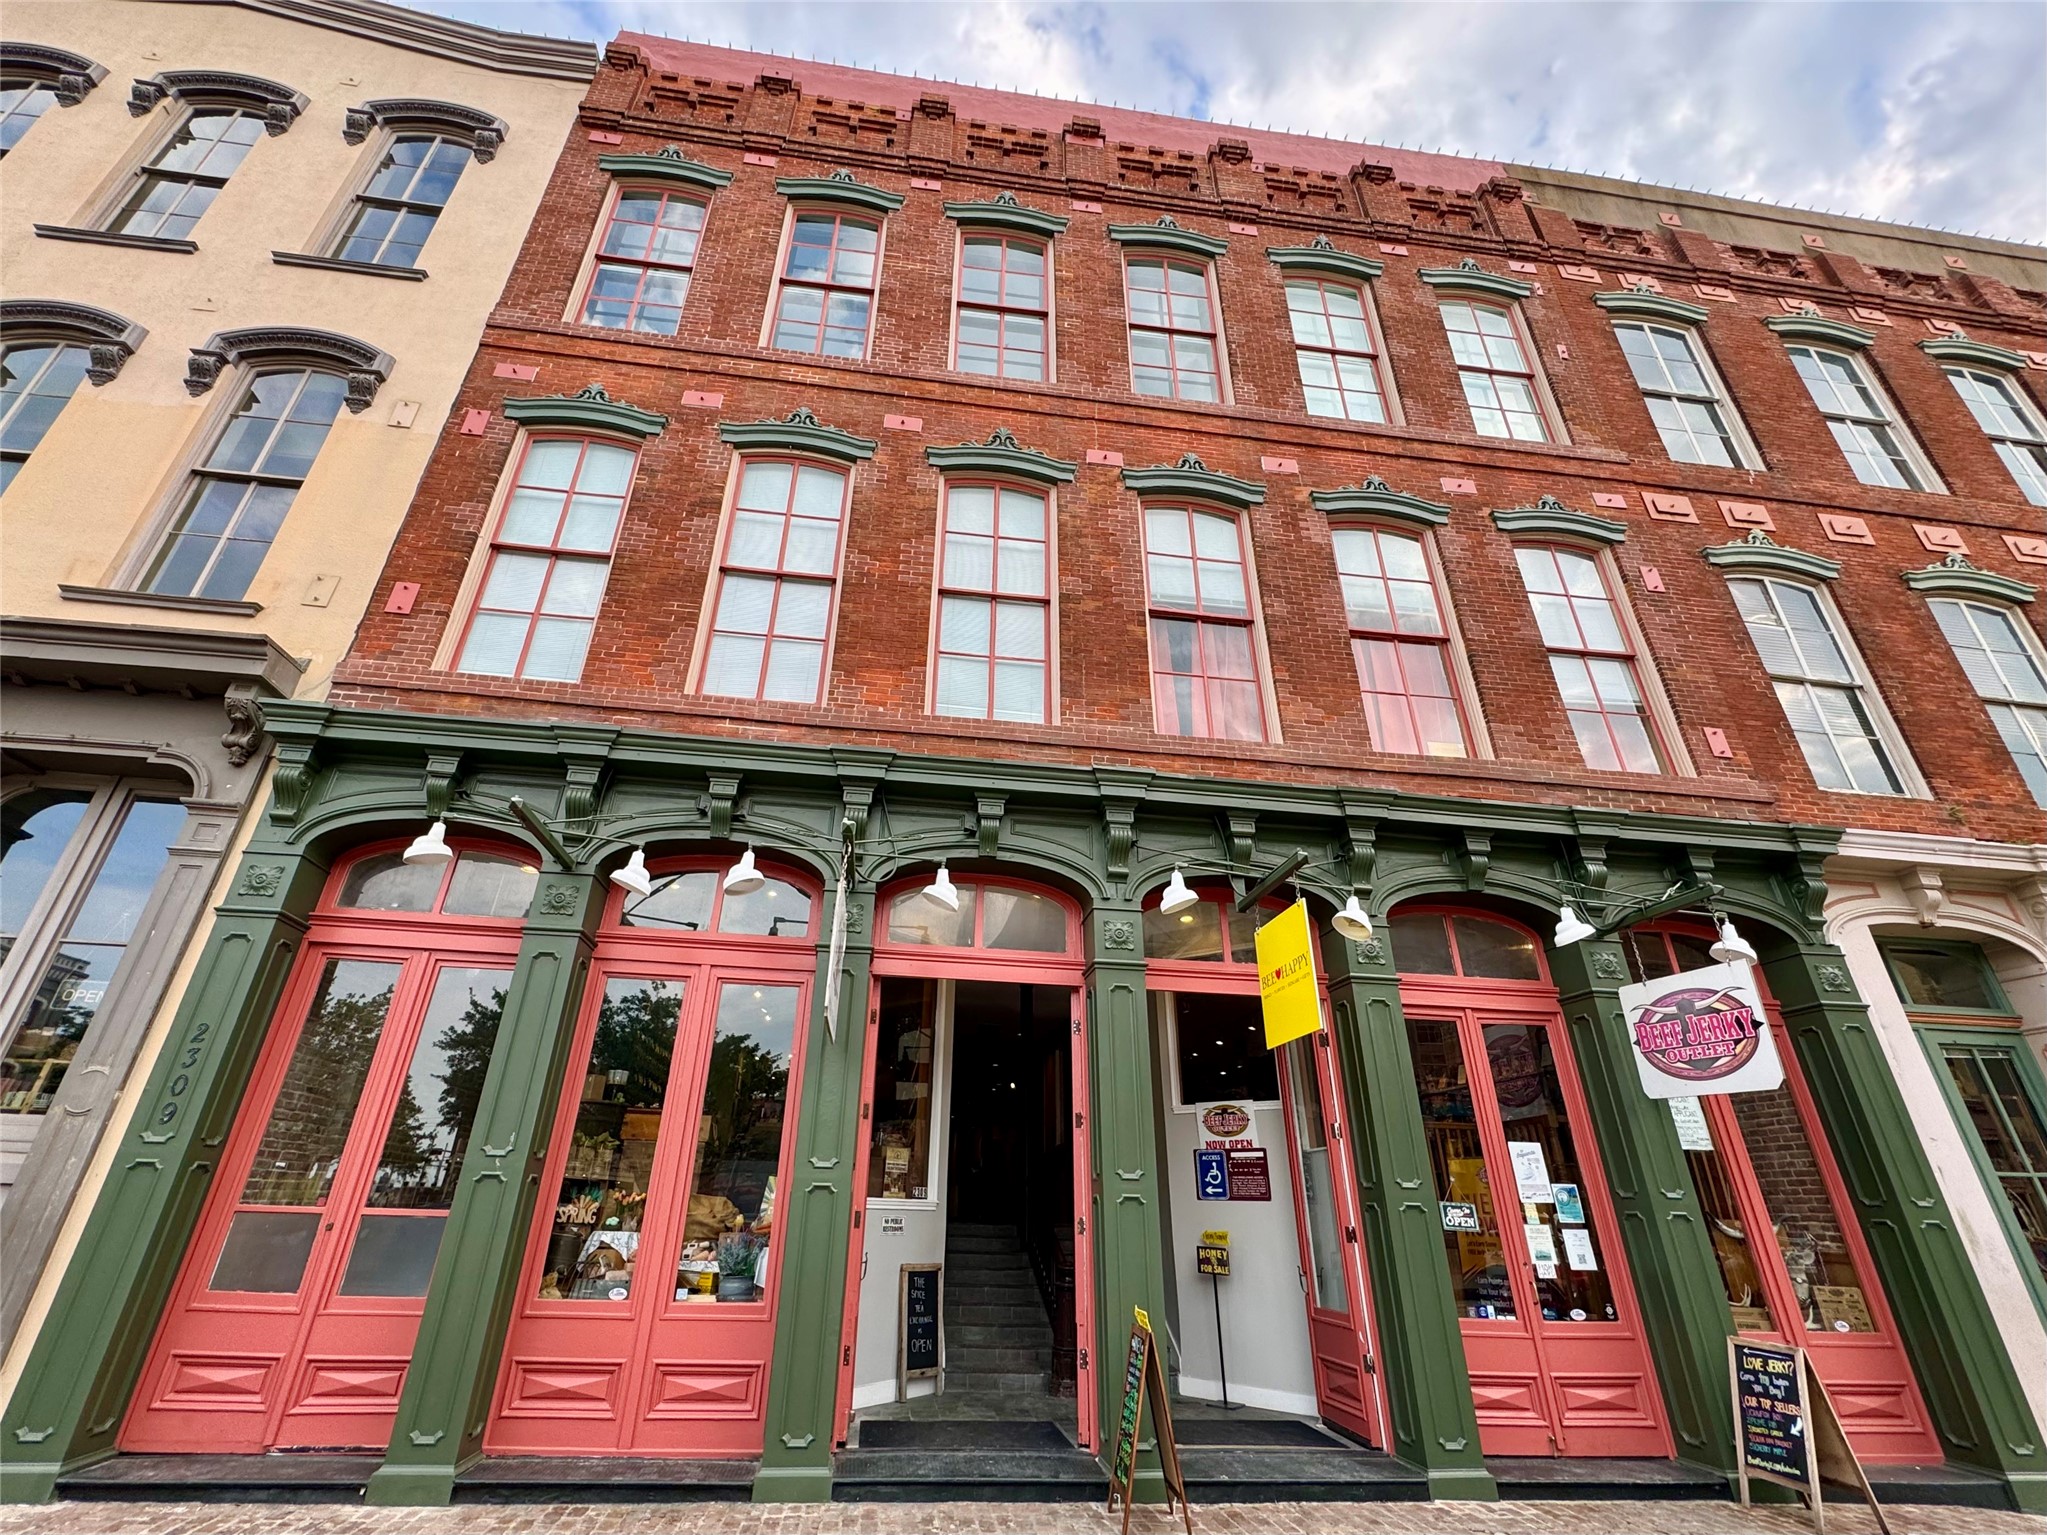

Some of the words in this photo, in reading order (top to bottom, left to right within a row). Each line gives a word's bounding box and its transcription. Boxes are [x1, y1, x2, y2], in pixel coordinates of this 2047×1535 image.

[1261, 971, 1276, 990] BEE
[1281, 951, 1308, 979] HAPPY
[1635, 1019, 1683, 1052] BEEF
[1685, 1007, 1755, 1045] JERKY
[1665, 1041, 1736, 1062] OUTLET
[159, 1022, 210, 1126] 2309
[1203, 1115, 1222, 1126] BEEF
[1223, 1113, 1248, 1126] JERKY
[1205, 1140, 1226, 1149] NOW
[1229, 1139, 1253, 1149] OPEN
[556, 1205, 597, 1224] SPRING
[1446, 1216, 1475, 1227] OPEN
[1199, 1248, 1228, 1260] HONEY
[1201, 1264, 1213, 1273] FOR
[1214, 1265, 1229, 1275] SALE
[913, 1276, 925, 1288] THE
[911, 1289, 926, 1300] SPICE
[914, 1304, 925, 1313] TEA
[911, 1339, 932, 1353] OPEN
[1744, 1395, 1758, 1407] OUR
[1759, 1398, 1772, 1411] TOP
[1774, 1401, 1802, 1416] SELLERS
